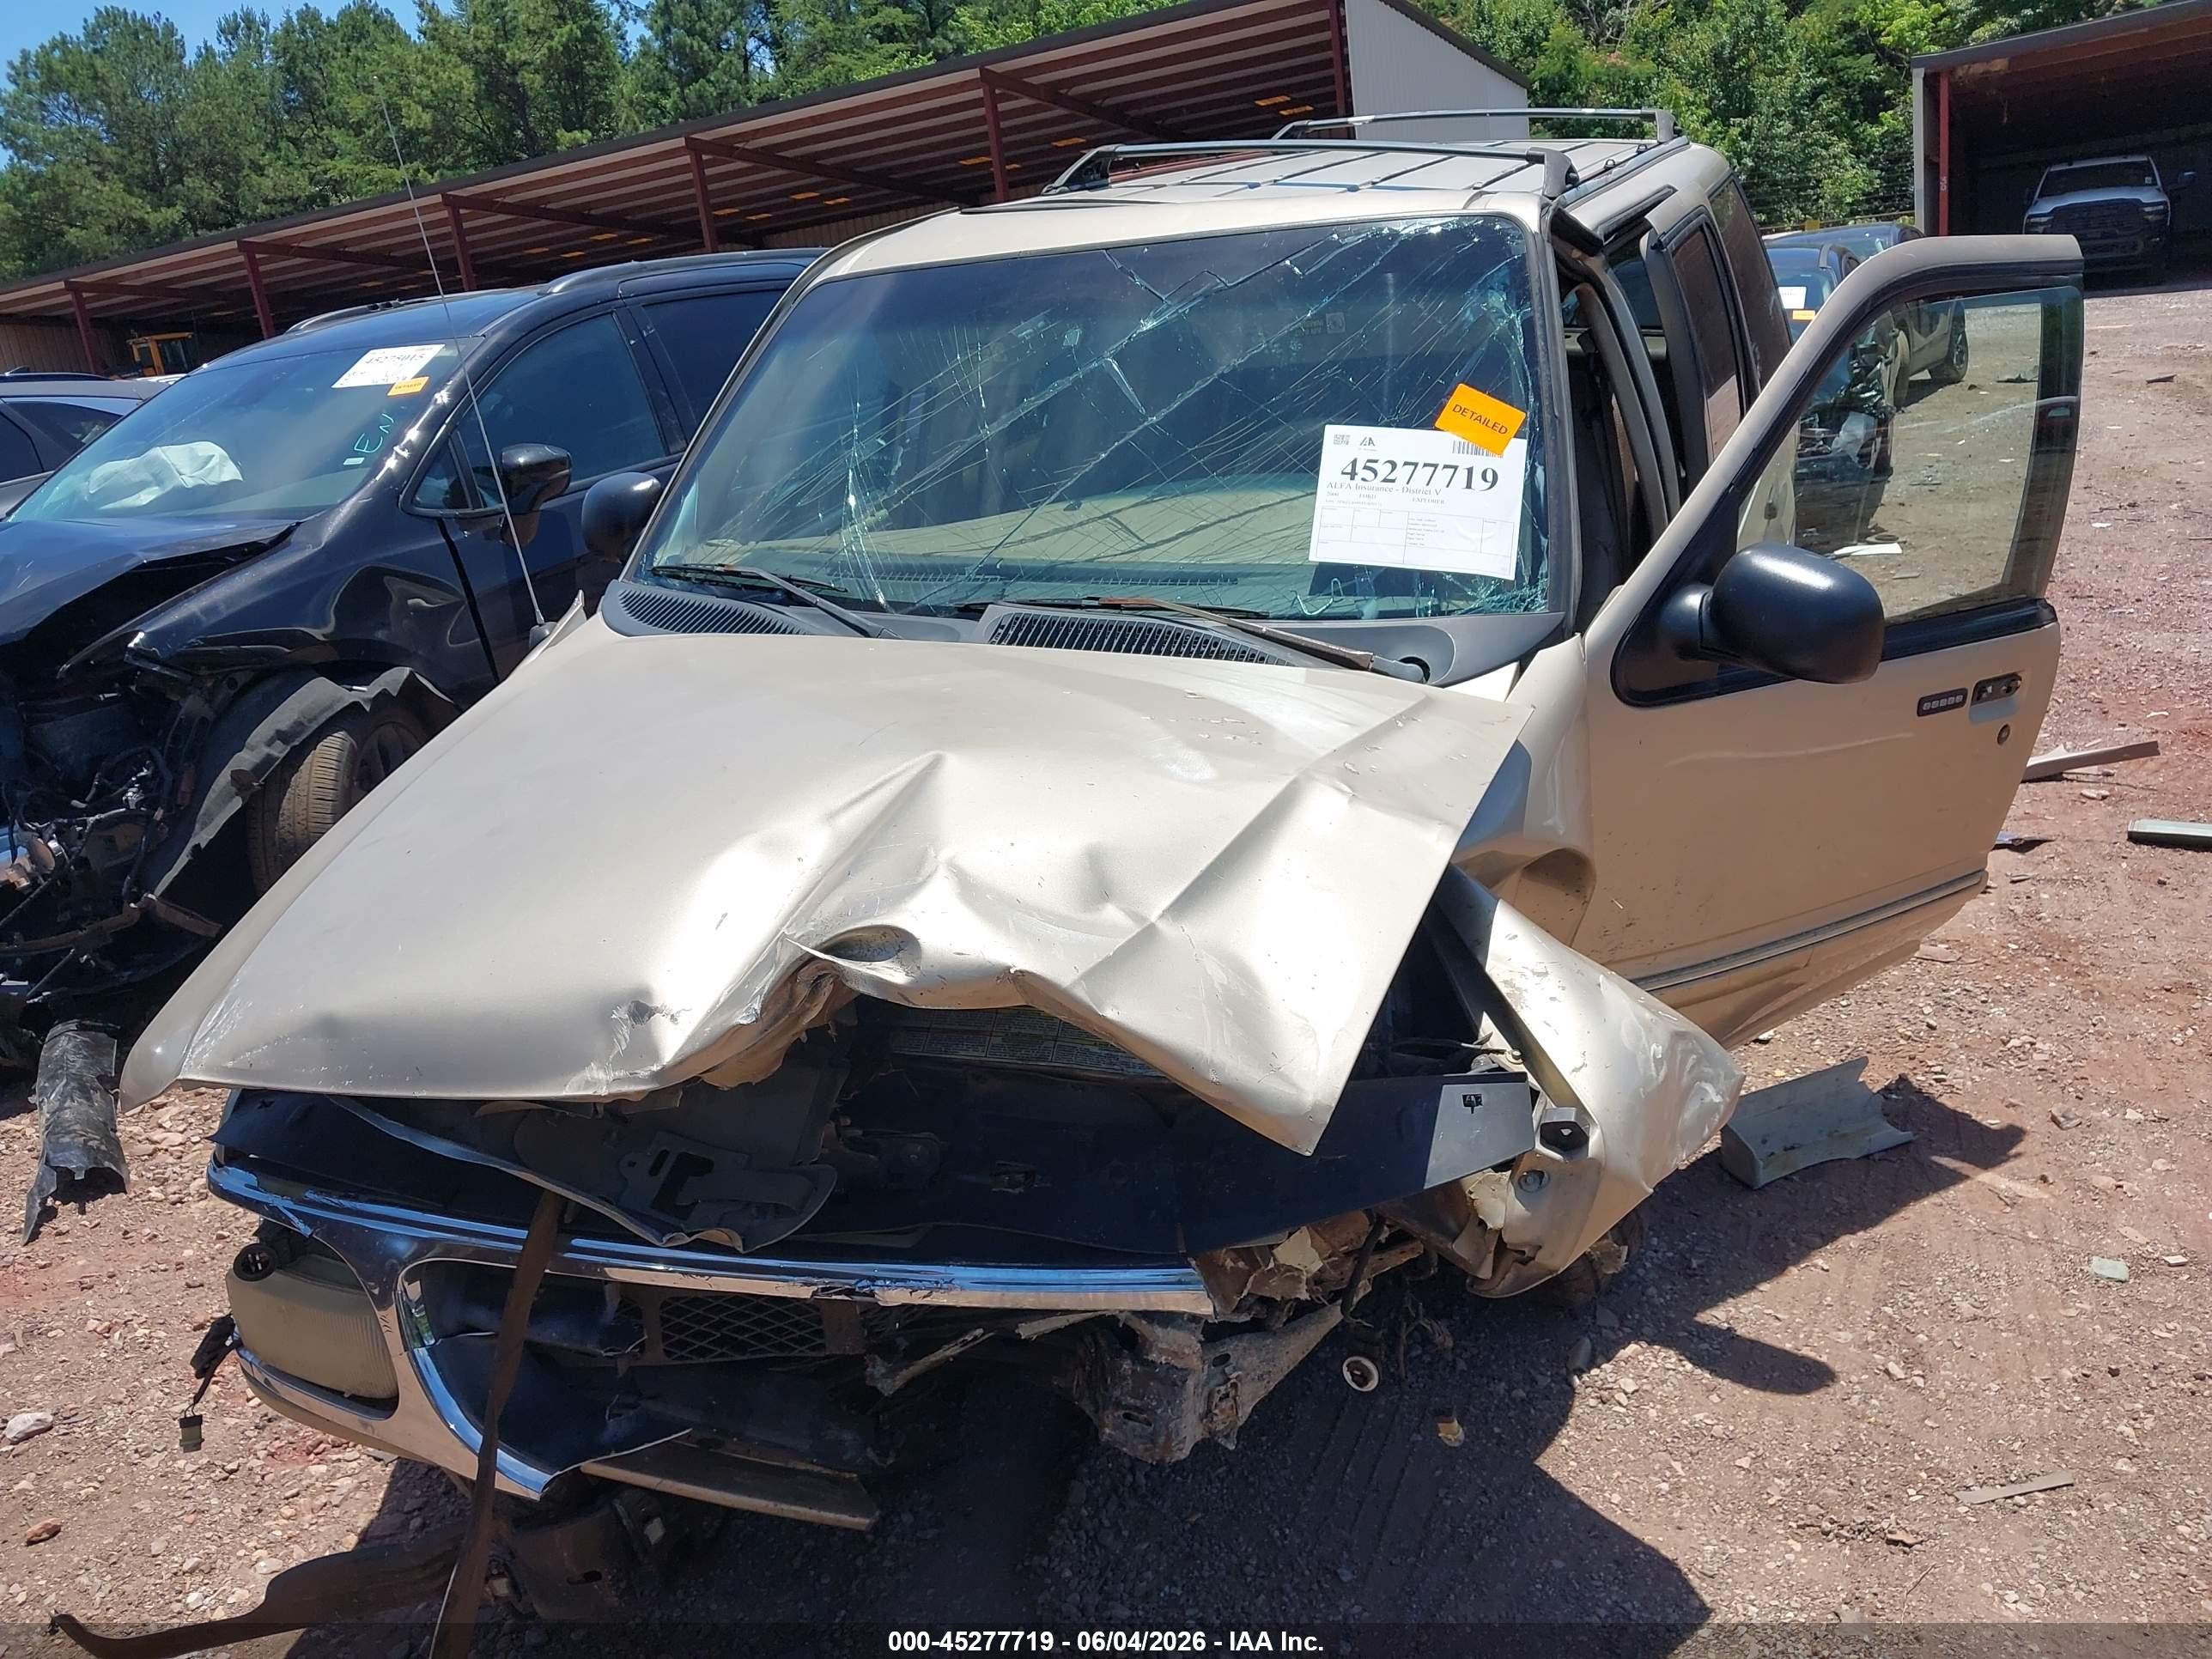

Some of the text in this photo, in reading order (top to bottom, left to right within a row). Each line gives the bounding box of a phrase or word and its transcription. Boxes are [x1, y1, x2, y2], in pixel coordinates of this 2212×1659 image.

[1452, 404, 1508, 434] DETAILED
[1327, 482, 1352, 490] ALFA
[1355, 483, 1394, 493] Insurance
[1401, 486, 1431, 495] District
[1341, 458, 1498, 492] 45277719
